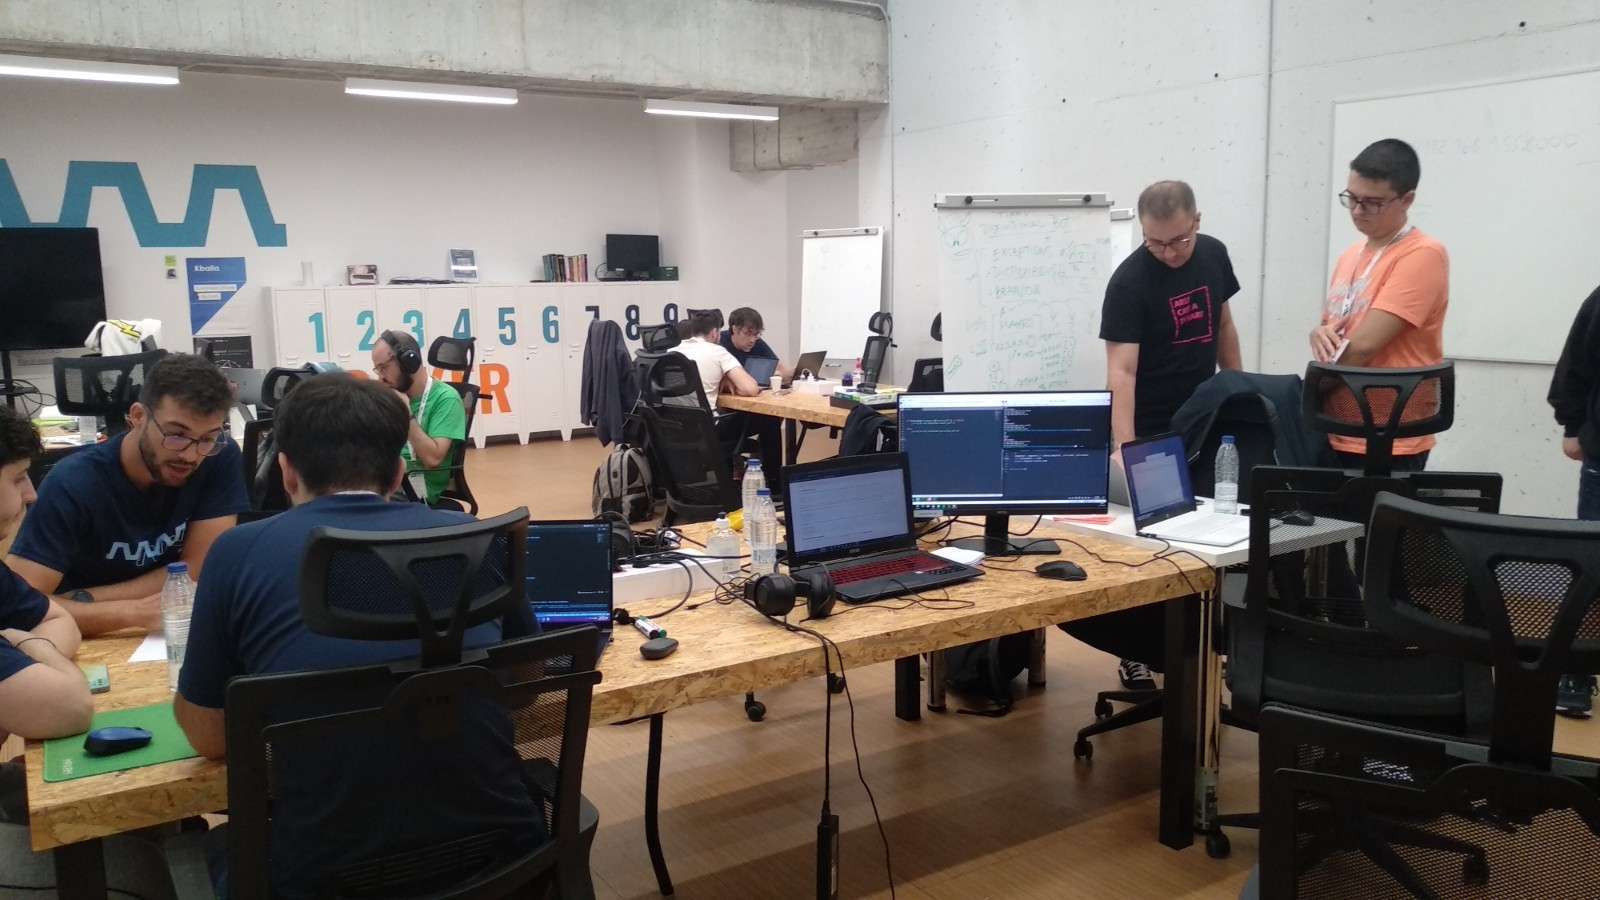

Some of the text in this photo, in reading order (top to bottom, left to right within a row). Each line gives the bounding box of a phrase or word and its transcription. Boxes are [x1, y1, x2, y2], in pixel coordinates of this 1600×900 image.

[309, 312, 325, 353] 1
[356, 311, 375, 353] 2
[403, 310, 424, 348] 3
[453, 310, 471, 340] 4
[498, 308, 516, 345] 5
[543, 306, 559, 343] 6
[625, 304, 640, 341] 8
